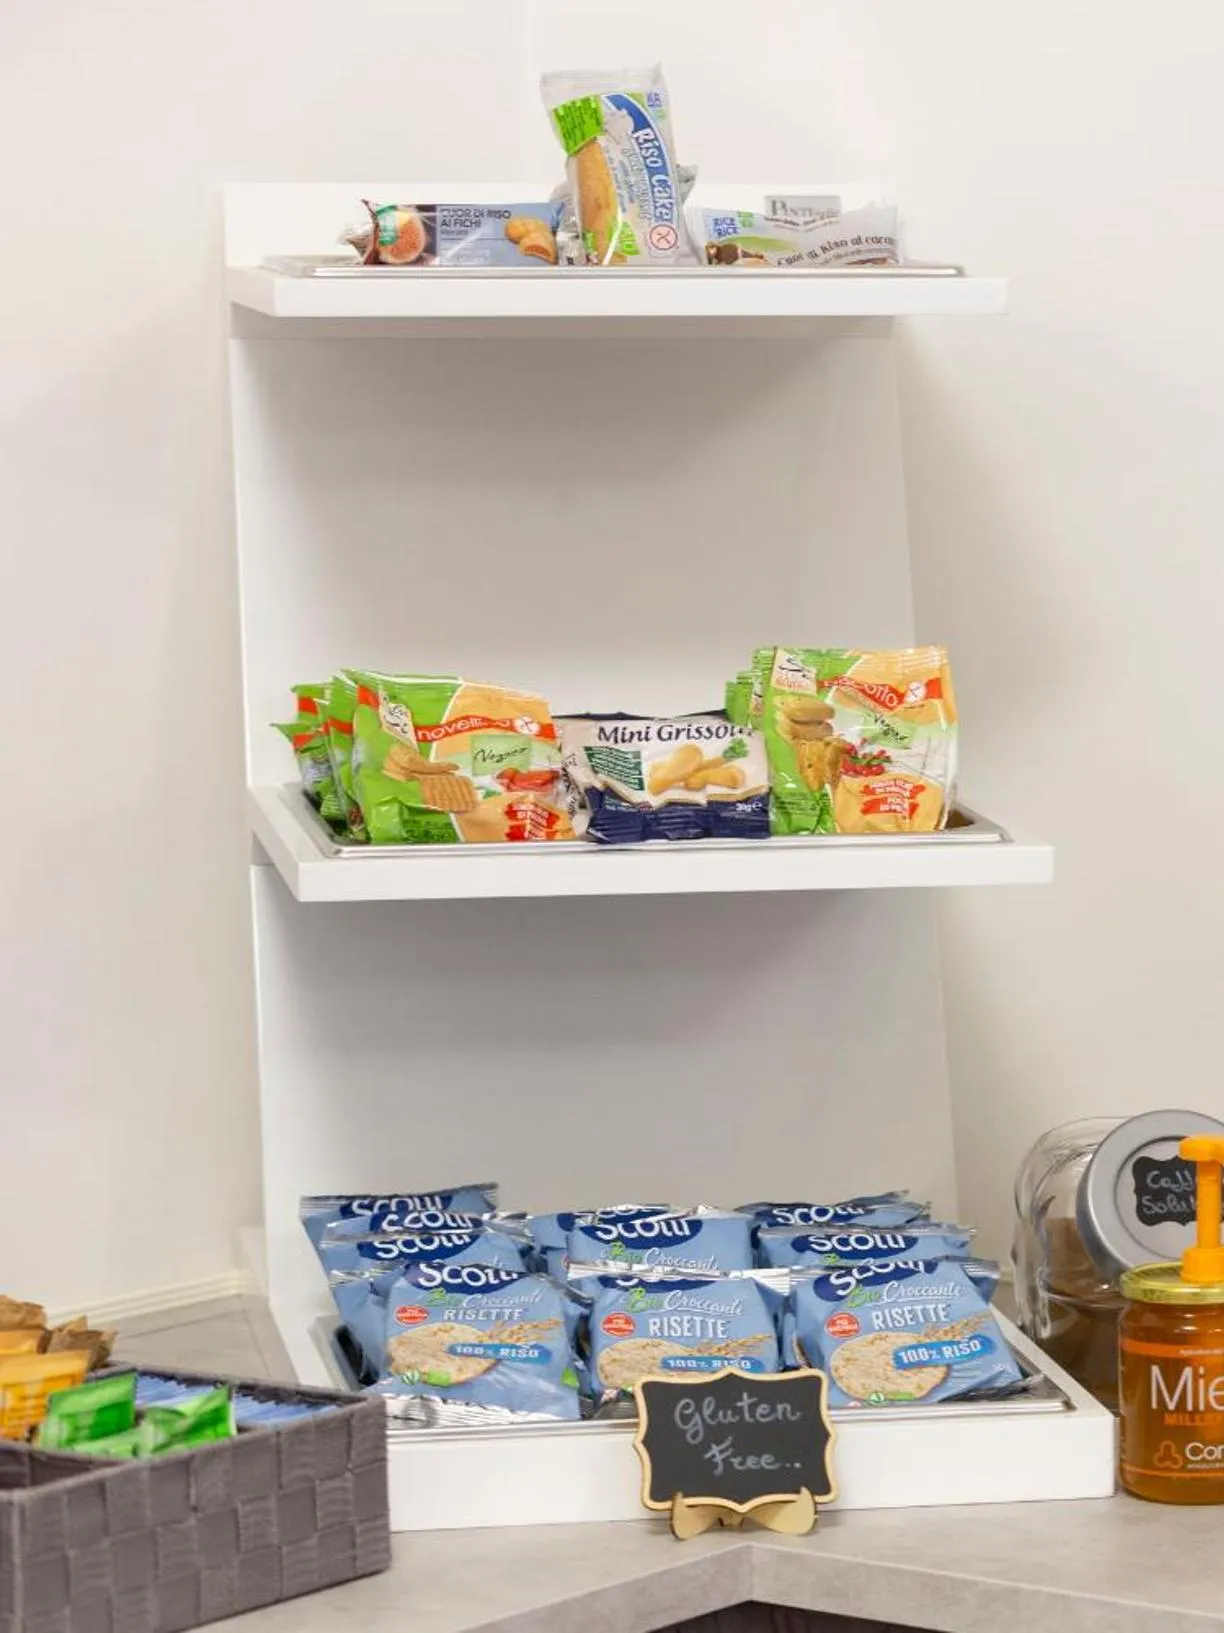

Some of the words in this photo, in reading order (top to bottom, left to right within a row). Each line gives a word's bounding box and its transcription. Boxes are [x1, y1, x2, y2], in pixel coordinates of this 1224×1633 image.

[632, 128, 663, 169] Riso
[651, 174, 676, 223] Cake
[598, 726, 650, 745] Mini
[443, 1308, 523, 1321] RISETTE
[649, 1315, 729, 1338] RISETTE
[871, 1303, 951, 1330] RISETTE
[500, 1347, 540, 1358] RISO
[899, 1349, 941, 1365] 100%
[943, 1339, 981, 1360] RISO
[674, 1391, 802, 1445] Gluten
